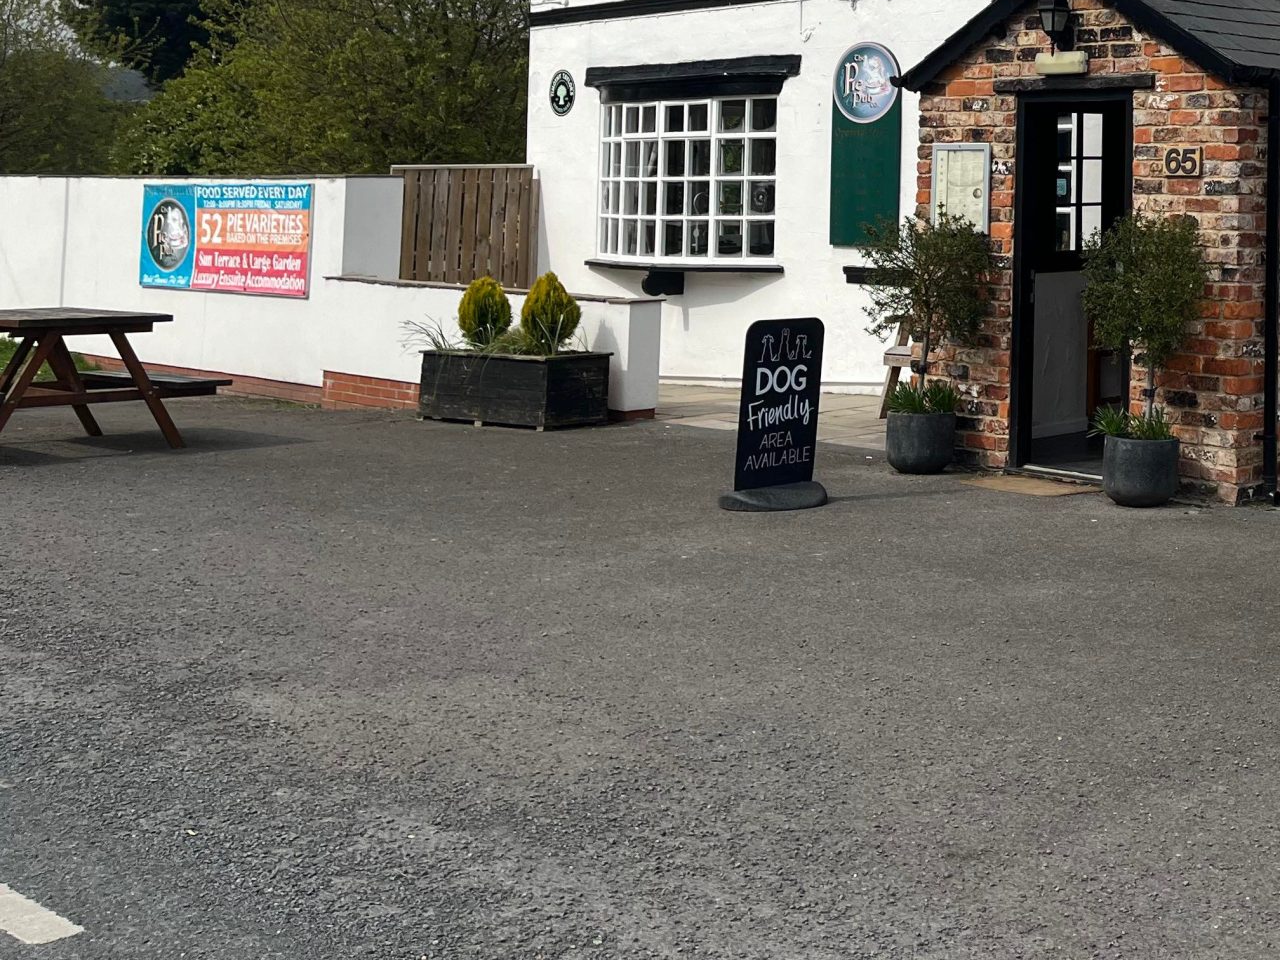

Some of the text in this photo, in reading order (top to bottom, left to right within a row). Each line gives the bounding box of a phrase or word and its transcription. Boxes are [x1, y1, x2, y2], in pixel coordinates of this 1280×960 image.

[1165, 148, 1198, 176] 65
[197, 186, 221, 199] FOOD
[222, 186, 257, 199] SERVED
[258, 186, 287, 199] EVERY
[288, 186, 308, 199] DAY
[201, 213, 303, 244] 52 PIE VARIETIES
[226, 232, 302, 245] BAKED ON THE PREMISES
[198, 252, 302, 273] Sun Terrace & Large Garden
[194, 272, 219, 289] Luxury
[219, 271, 245, 286] Ensuite
[245, 271, 305, 290] Accommodation
[755, 364, 808, 396] DOG
[746, 394, 815, 431] Friendly
[759, 430, 793, 450] AREA
[744, 445, 811, 472] AVAILABLE
